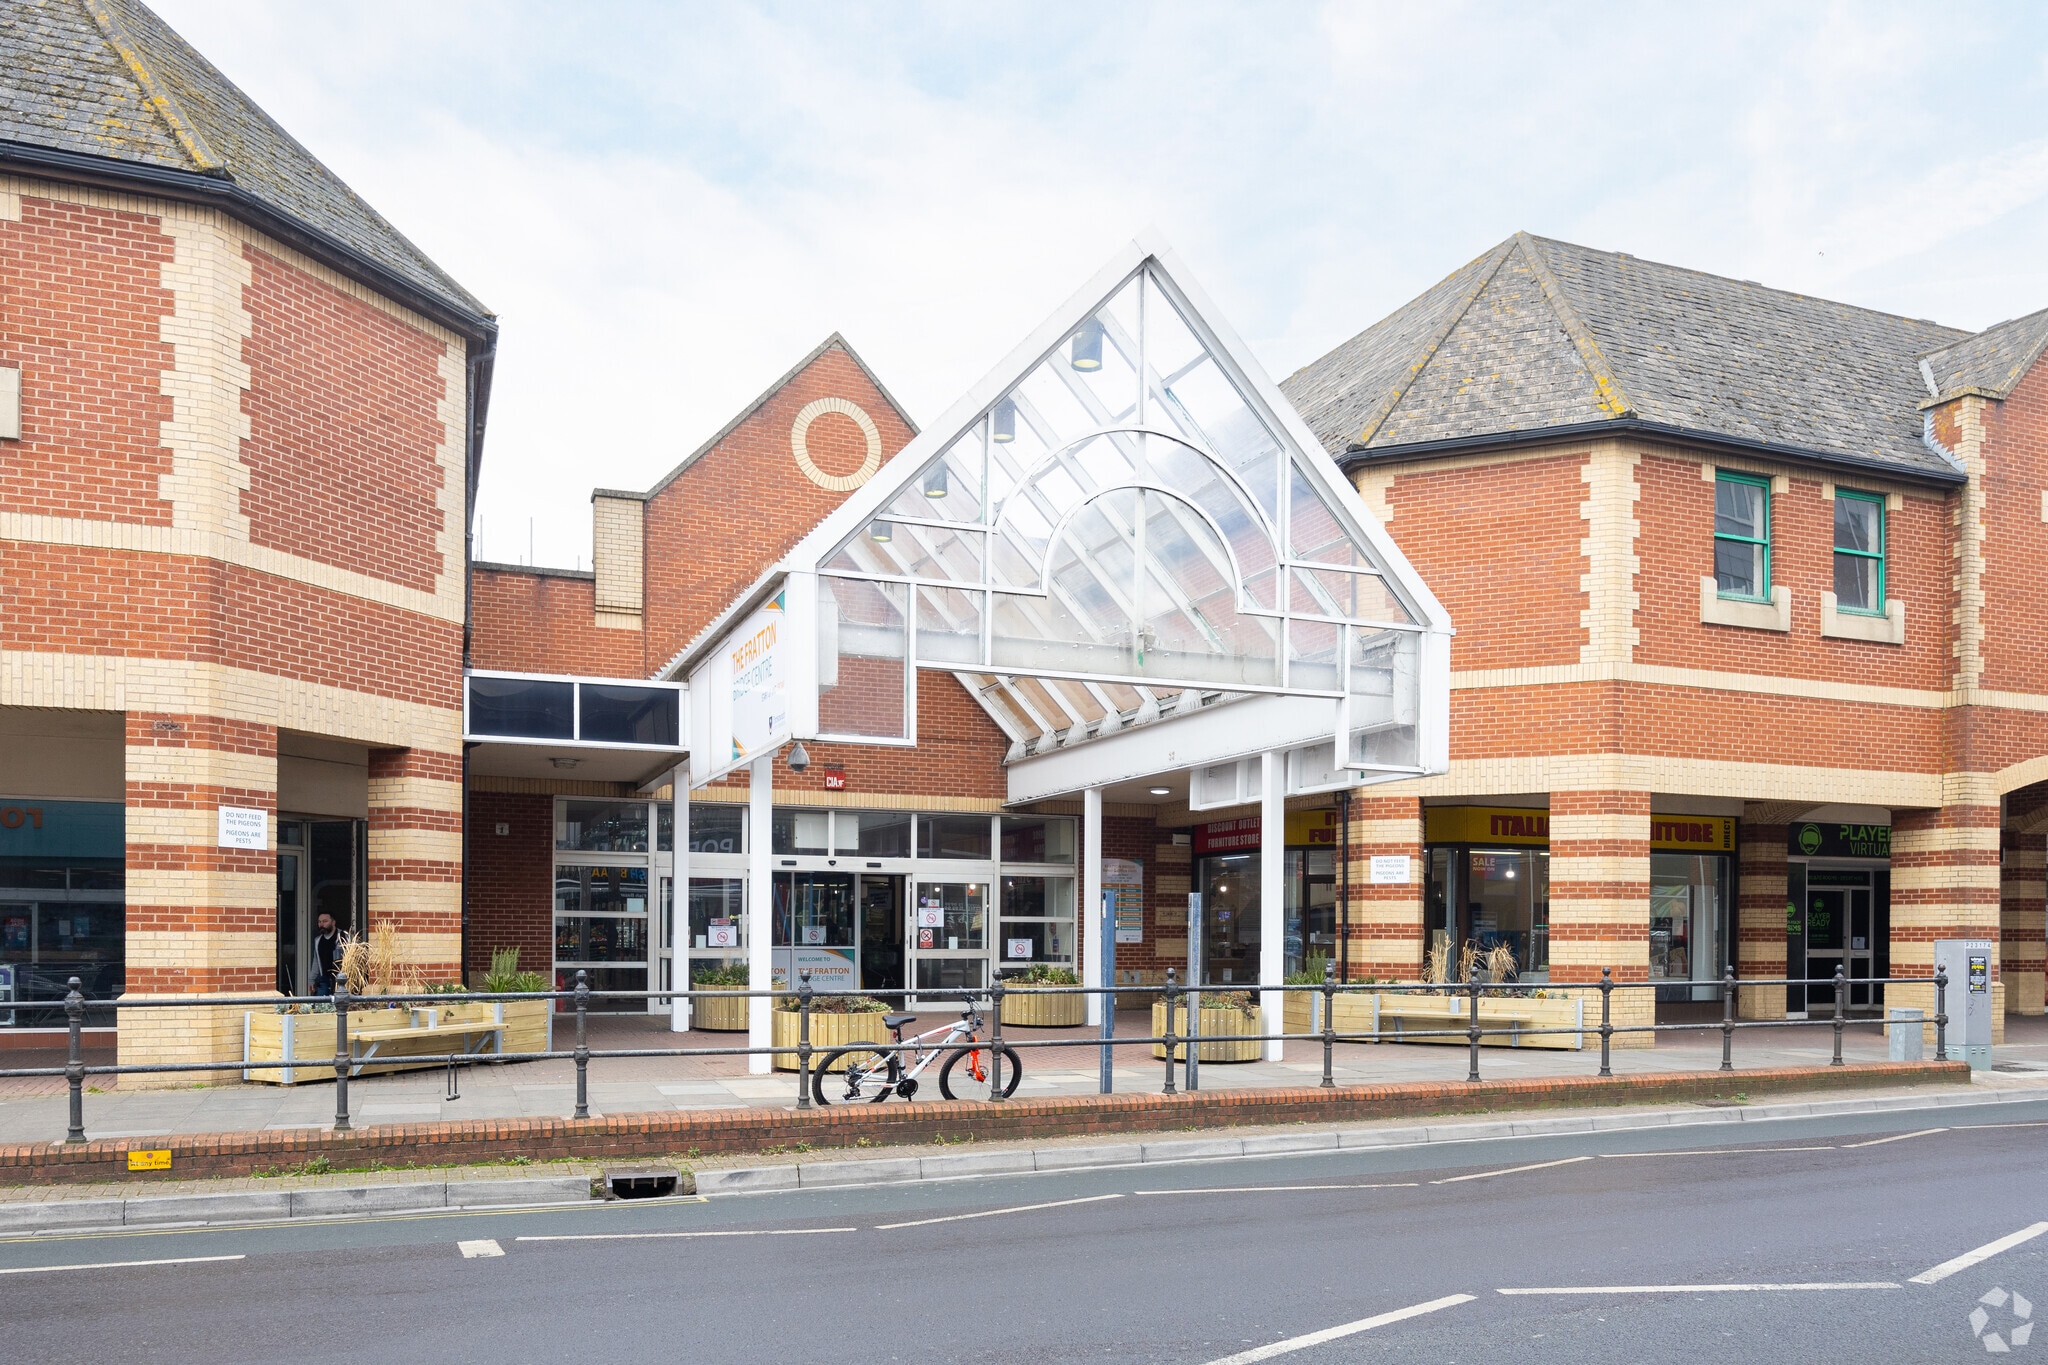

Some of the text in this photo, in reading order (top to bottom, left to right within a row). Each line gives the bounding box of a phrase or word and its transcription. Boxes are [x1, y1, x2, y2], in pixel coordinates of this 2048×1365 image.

[732, 620, 777, 675] THE FRATTON
[225, 829, 250, 837] PIGEONS
[1207, 817, 1260, 834] DISCOUNT OUTLET
[1490, 814, 1550, 838] ITALI
[1650, 821, 1714, 843] ITURE
[1723, 820, 1731, 849] DIRECT
[1207, 833, 1260, 849] FURNITURE STORE
[1472, 857, 1495, 867] SALE
